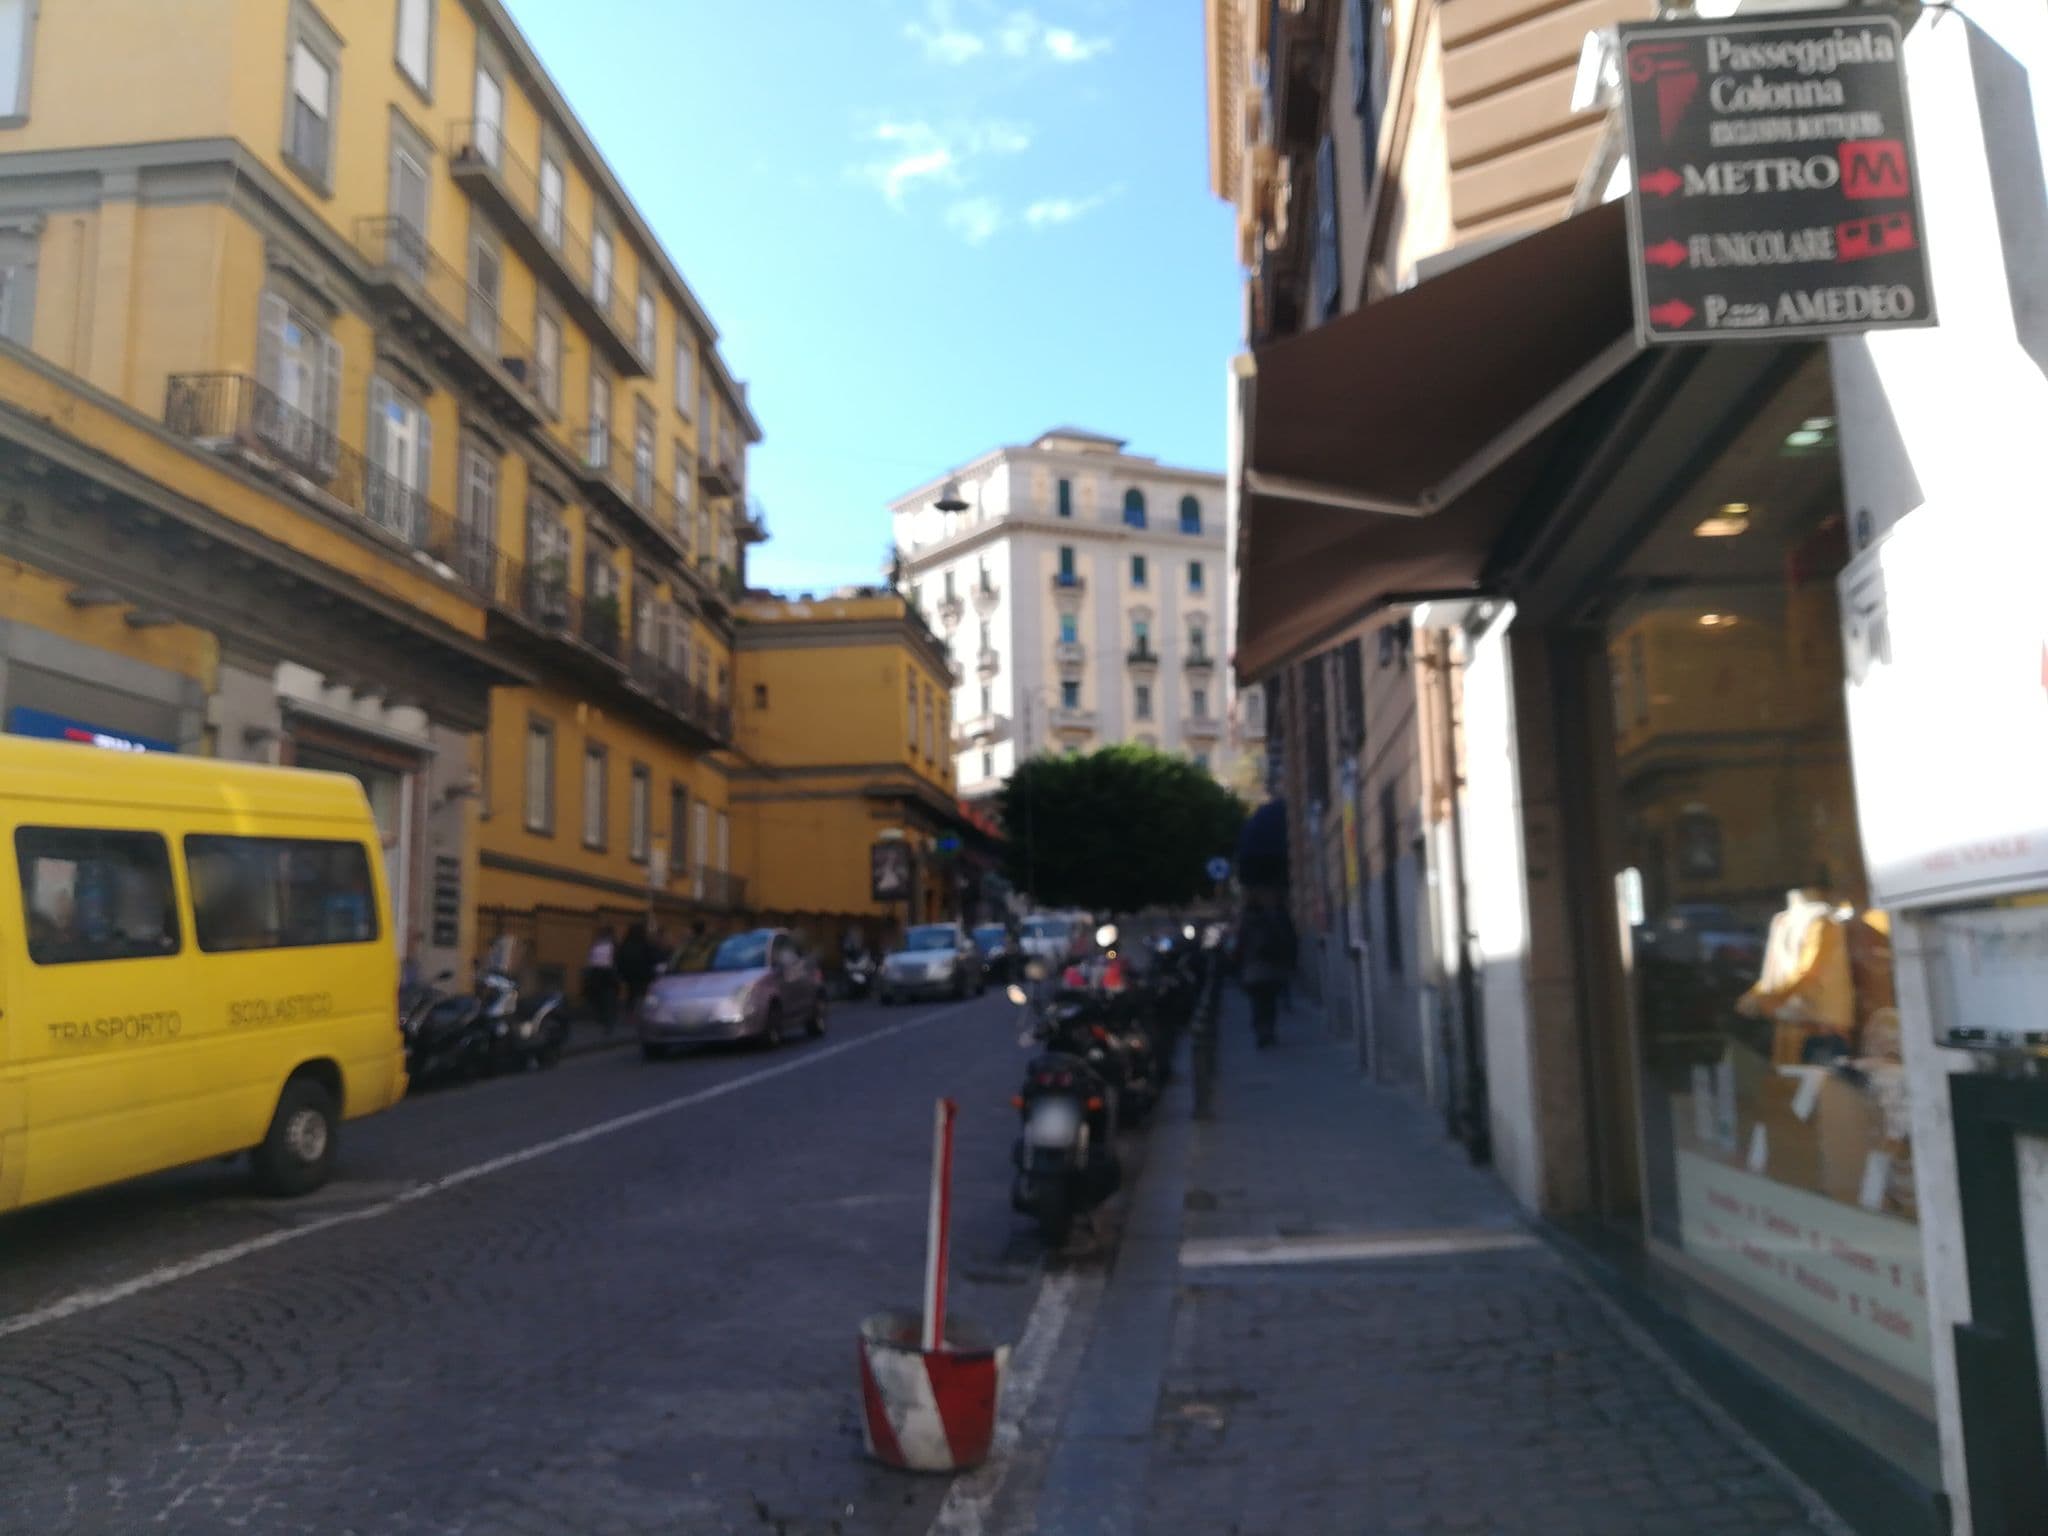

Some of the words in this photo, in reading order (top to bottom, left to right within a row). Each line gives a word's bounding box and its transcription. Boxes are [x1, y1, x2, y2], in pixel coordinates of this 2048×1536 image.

[1711, 75, 1844, 113] Colonna
[1683, 155, 1840, 197] METRO
[1690, 227, 1836, 268] FUNICOLARE
[1774, 285, 1915, 326] AMEDEO
[48, 1010, 183, 1042] TRASPORTO
[230, 991, 333, 1025] SCOLASTICO
